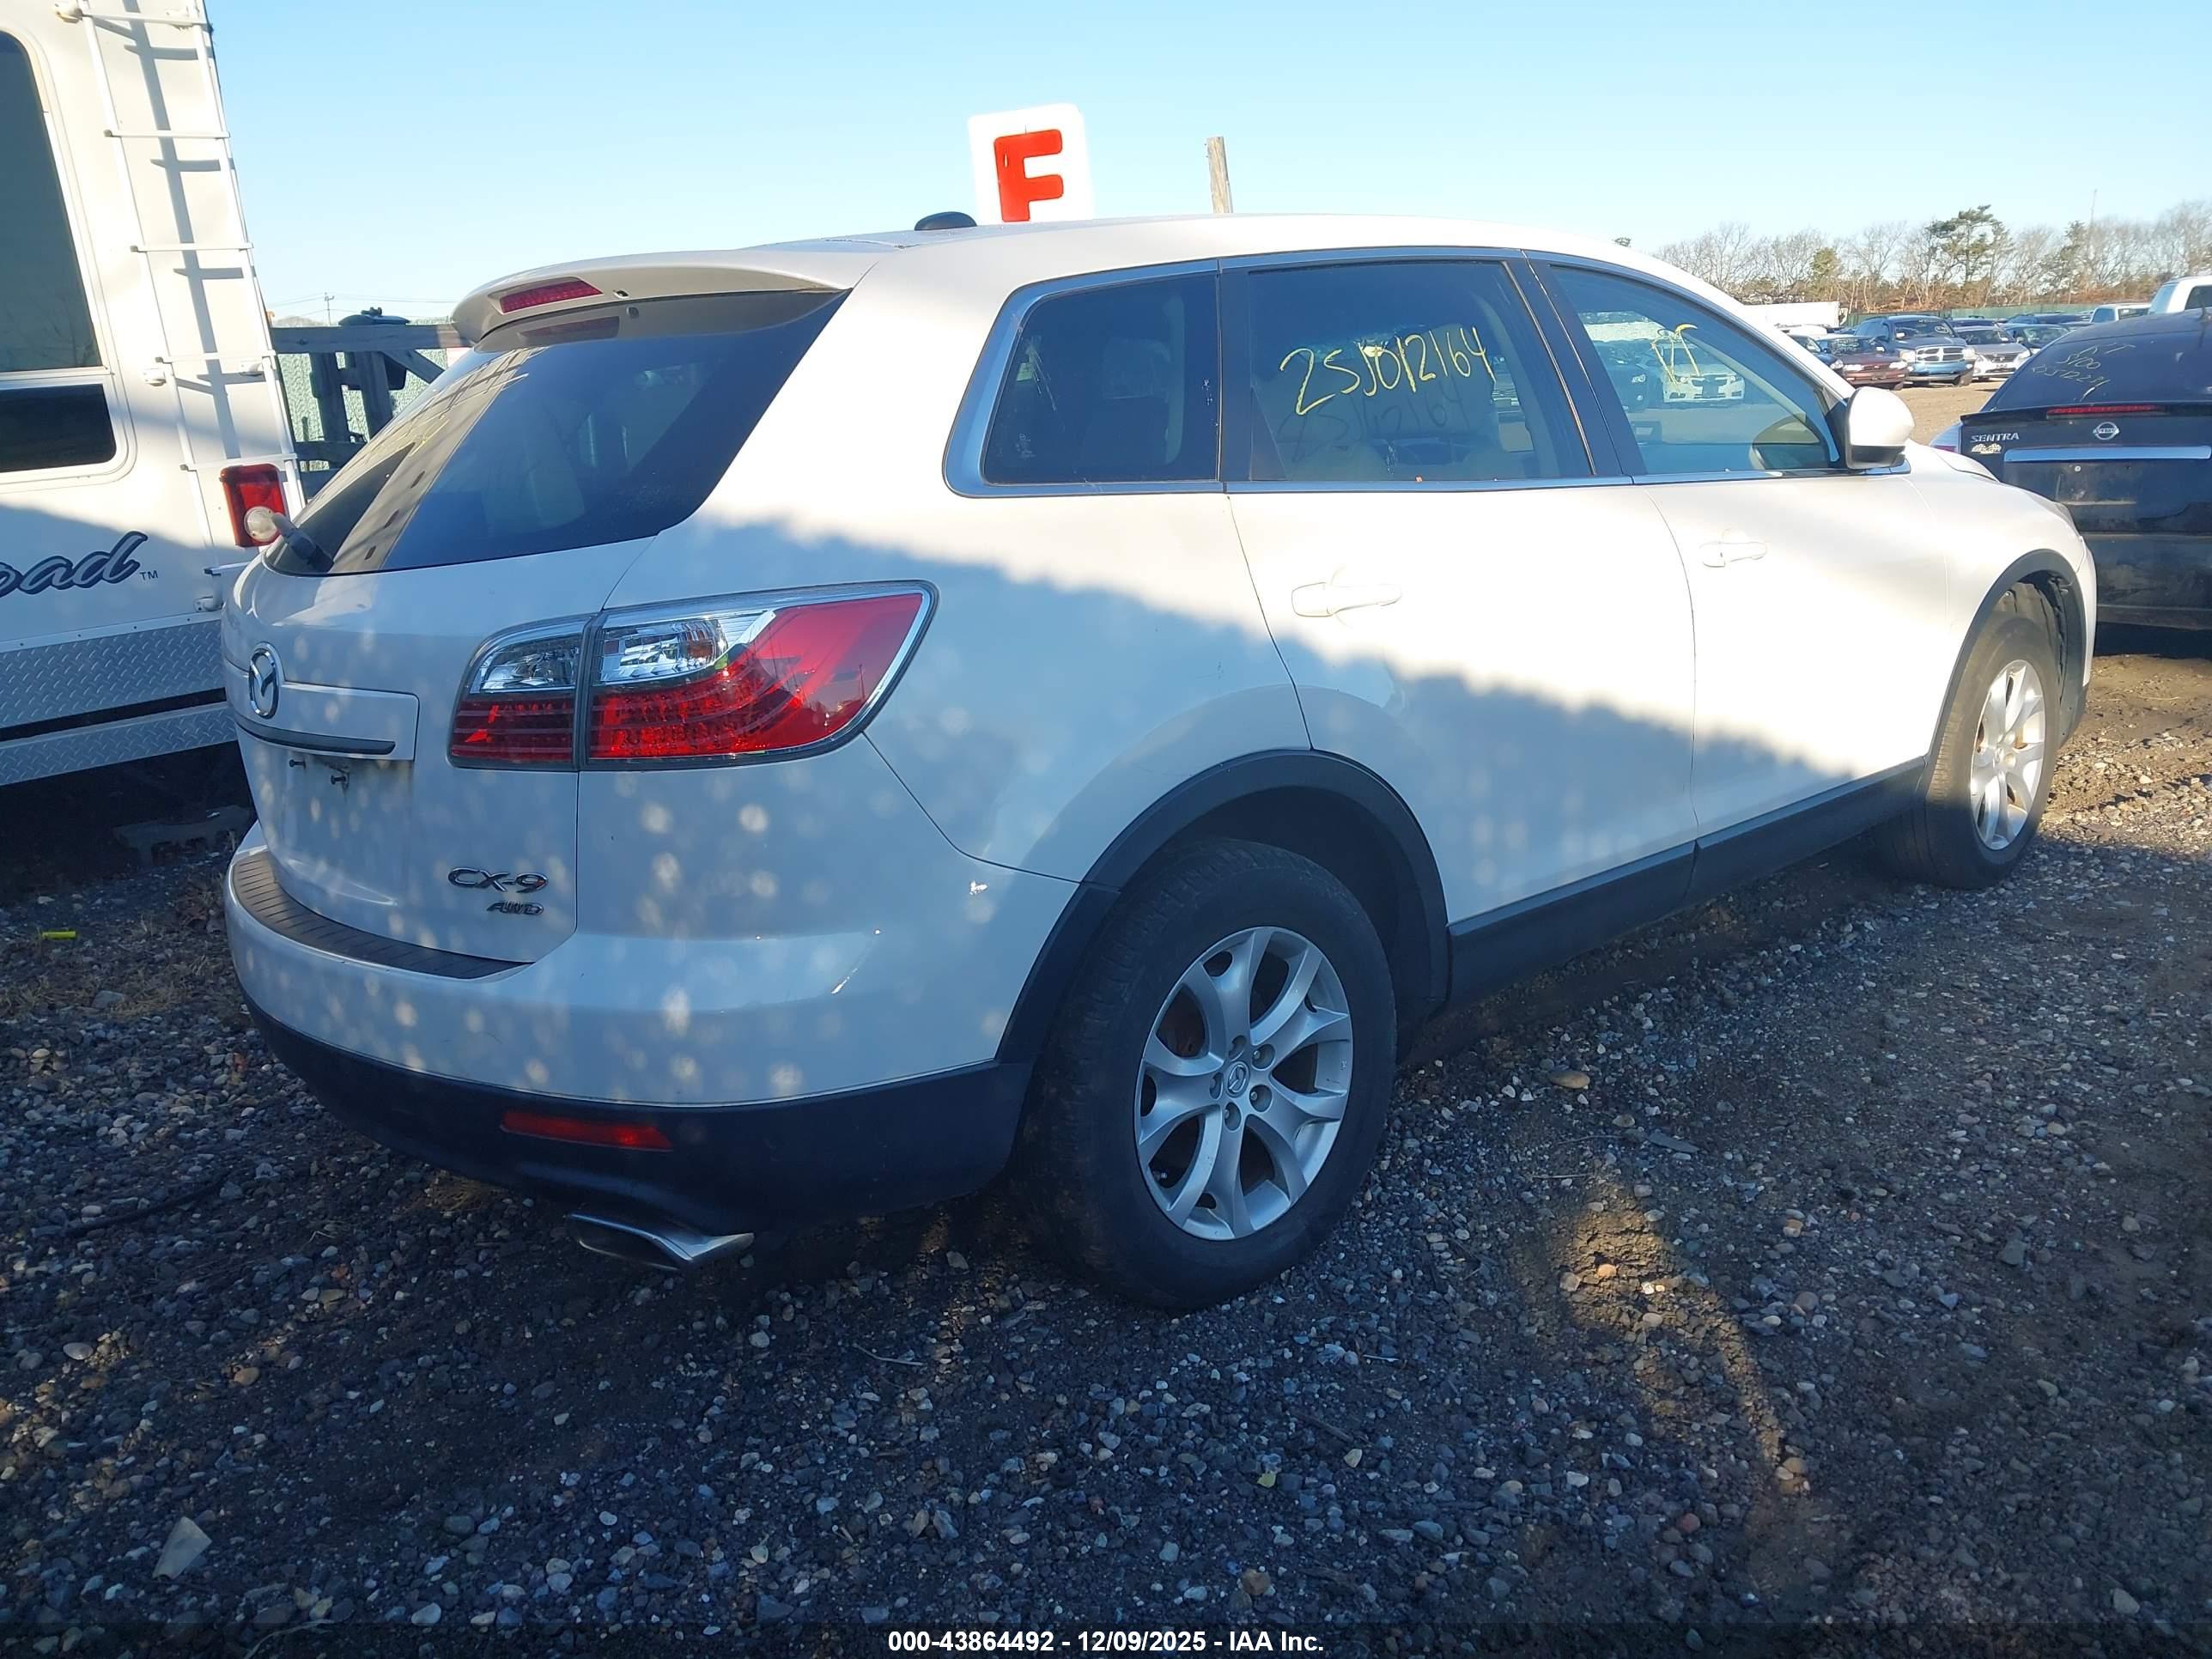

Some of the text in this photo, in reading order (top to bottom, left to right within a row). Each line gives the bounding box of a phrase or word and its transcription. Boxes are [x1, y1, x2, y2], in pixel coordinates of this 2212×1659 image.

[994, 129, 1064, 222] F
[1971, 432, 2020, 443] SENTRA
[447, 866, 550, 893] CX-9
[486, 900, 544, 915] AWD
